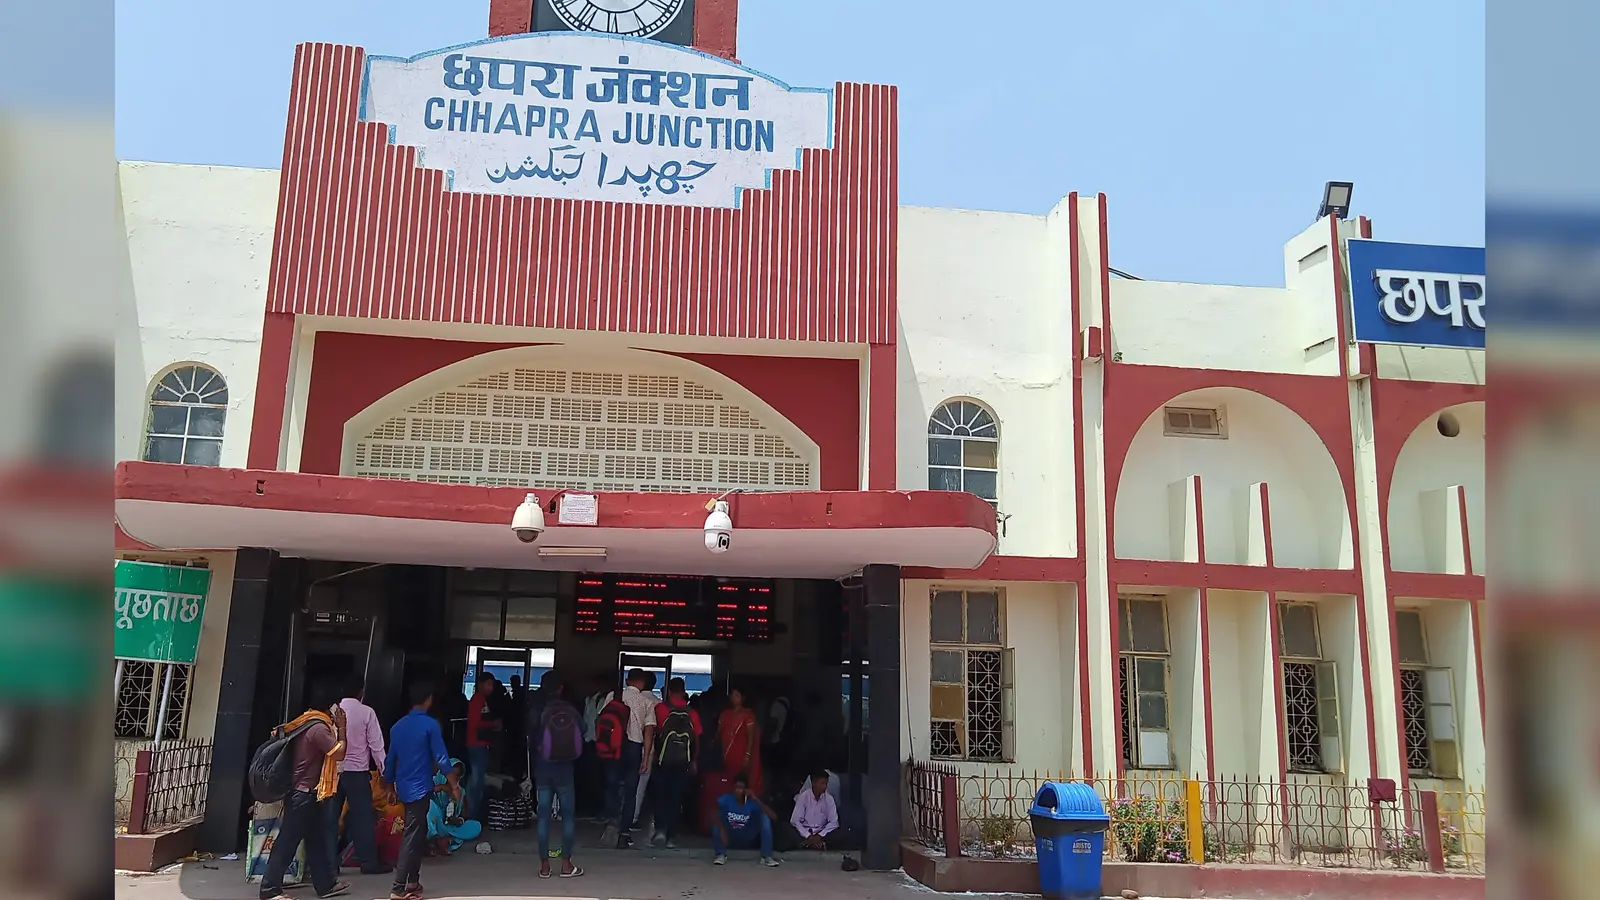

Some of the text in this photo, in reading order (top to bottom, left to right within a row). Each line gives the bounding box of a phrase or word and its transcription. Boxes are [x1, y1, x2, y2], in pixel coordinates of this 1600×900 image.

[443, 53, 754, 111] छपरा जंक्शन
[424, 97, 774, 153] CHHAPRA JUNCTION
[115, 587, 203, 629] पूछताछ
